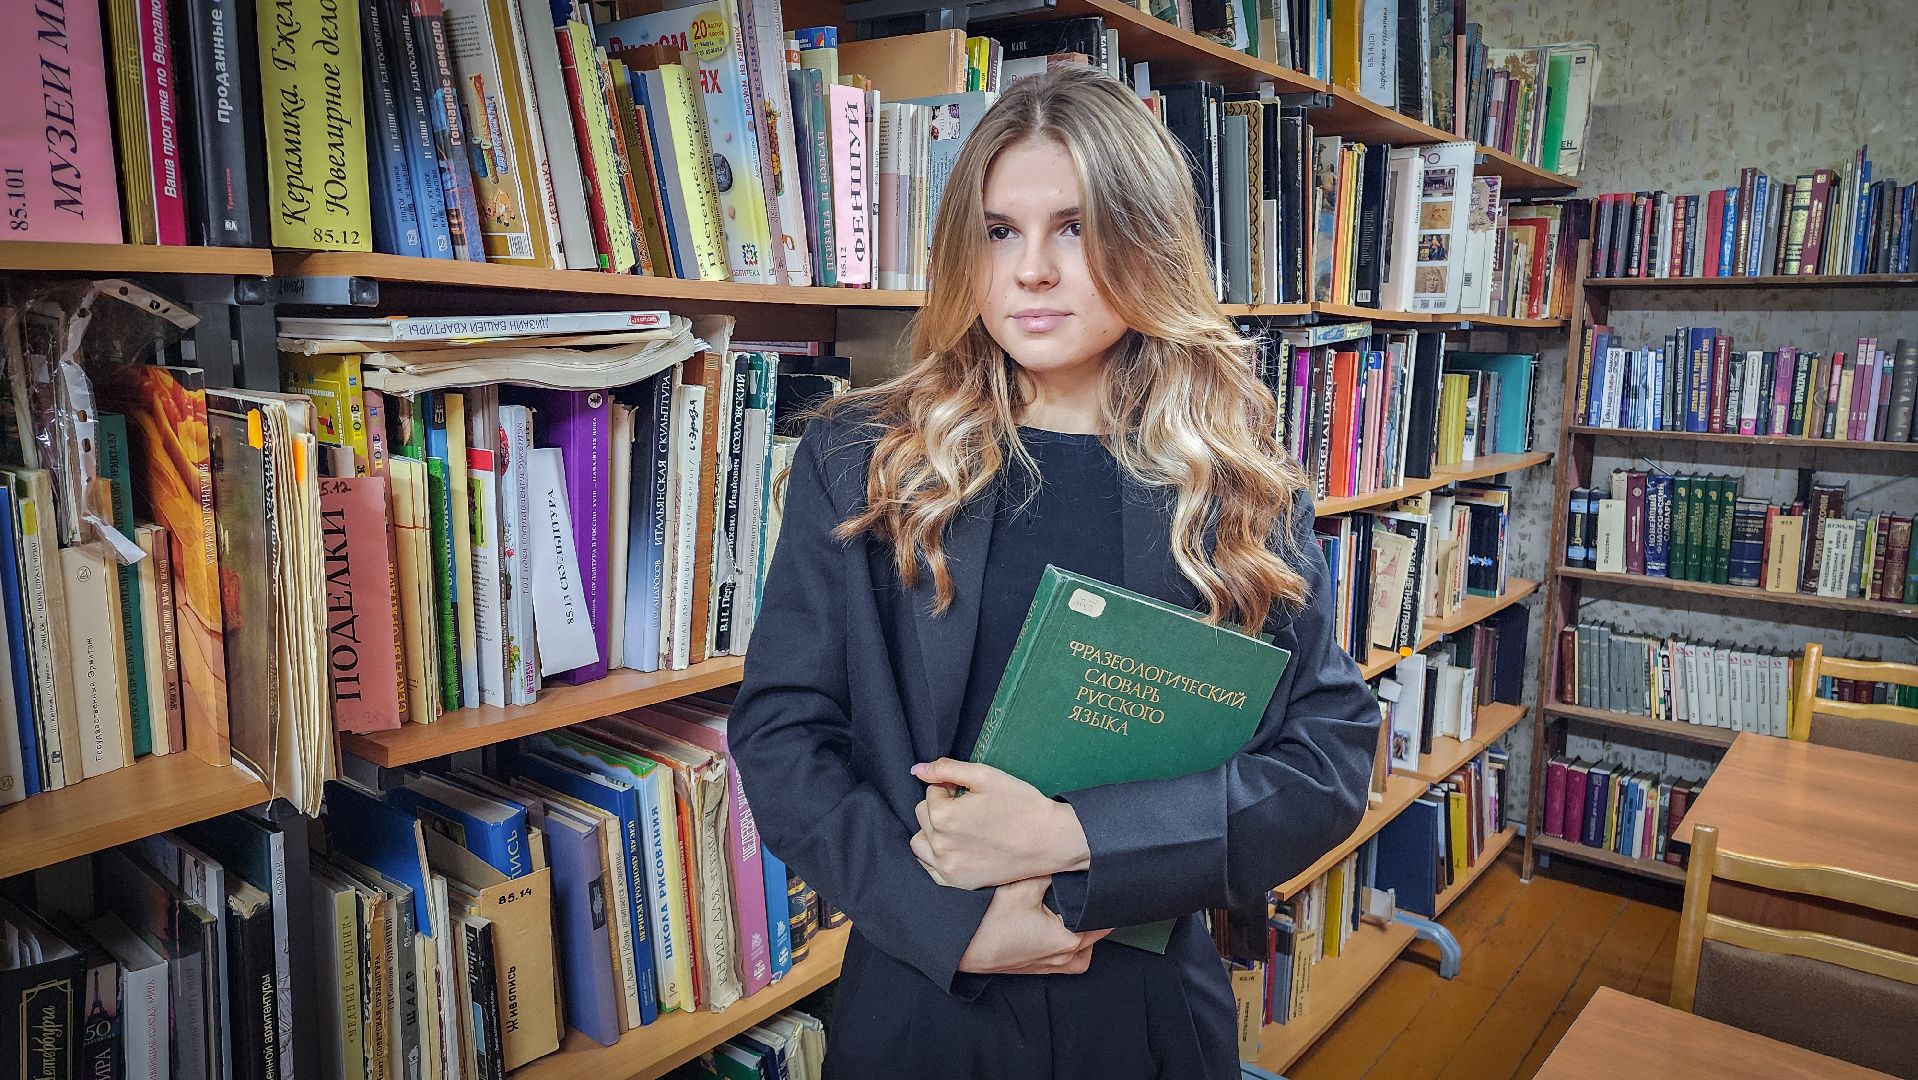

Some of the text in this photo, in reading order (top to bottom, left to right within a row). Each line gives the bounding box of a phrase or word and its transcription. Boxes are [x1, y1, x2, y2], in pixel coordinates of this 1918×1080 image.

[692, 20, 708, 41] 20
[156, 68, 168, 87] по
[214, 9, 233, 124] Проданные
[430, 20, 461, 146] Гончарное ремесло
[733, 26, 753, 117] Рисуем на камнях
[39, 54, 85, 221] МУЗЕИ
[158, 90, 174, 156] прогулка
[280, 83, 314, 226] Керамика.
[322, 67, 353, 217] Ювелирное
[5, 168, 29, 231] 85.101
[165, 160, 178, 198] Ваша
[313, 227, 360, 246] 85.12
[840, 246, 848, 277] 85.12
[409, 317, 549, 336] ДИЗАЙН ВАШЕЙ КВАРТИРЫ
[732, 372, 746, 454] КОЗЛОВСКИЙ
[1317, 349, 1335, 500] МИКЕЛАНДЖЕЛО
[654, 374, 671, 546] ИТАЛЬЯНСКАЯ СКУЛЬПТУРА
[199, 463, 216, 566] ЯНТАРНАЯ КОМНАТА
[546, 488, 575, 625] 85.13 СКУЛЬПТУРА
[322, 508, 361, 702] ПОДЕЛКИ
[85, 637, 95, 678] Эрмитаж
[1068, 640, 1247, 710] ФРАЗЕОЛОГИЧЕСКИЙ
[1084, 668, 1160, 703] СЛОВАРЬ
[1068, 705, 1130, 737] ЯЗЫКА
[1075, 686, 1164, 724] РУССКОГО
[627, 819, 639, 853] МУЗЕЙ
[498, 887, 533, 905] 85.14
[631, 856, 643, 904] ГРОЗНОМУ
[651, 805, 673, 960] ШКОЛА РИСОВАНИЯ
[84, 1020, 111, 1042] 50
[261, 974, 275, 1043] архитектуры
[506, 965, 521, 1034] Живопись
